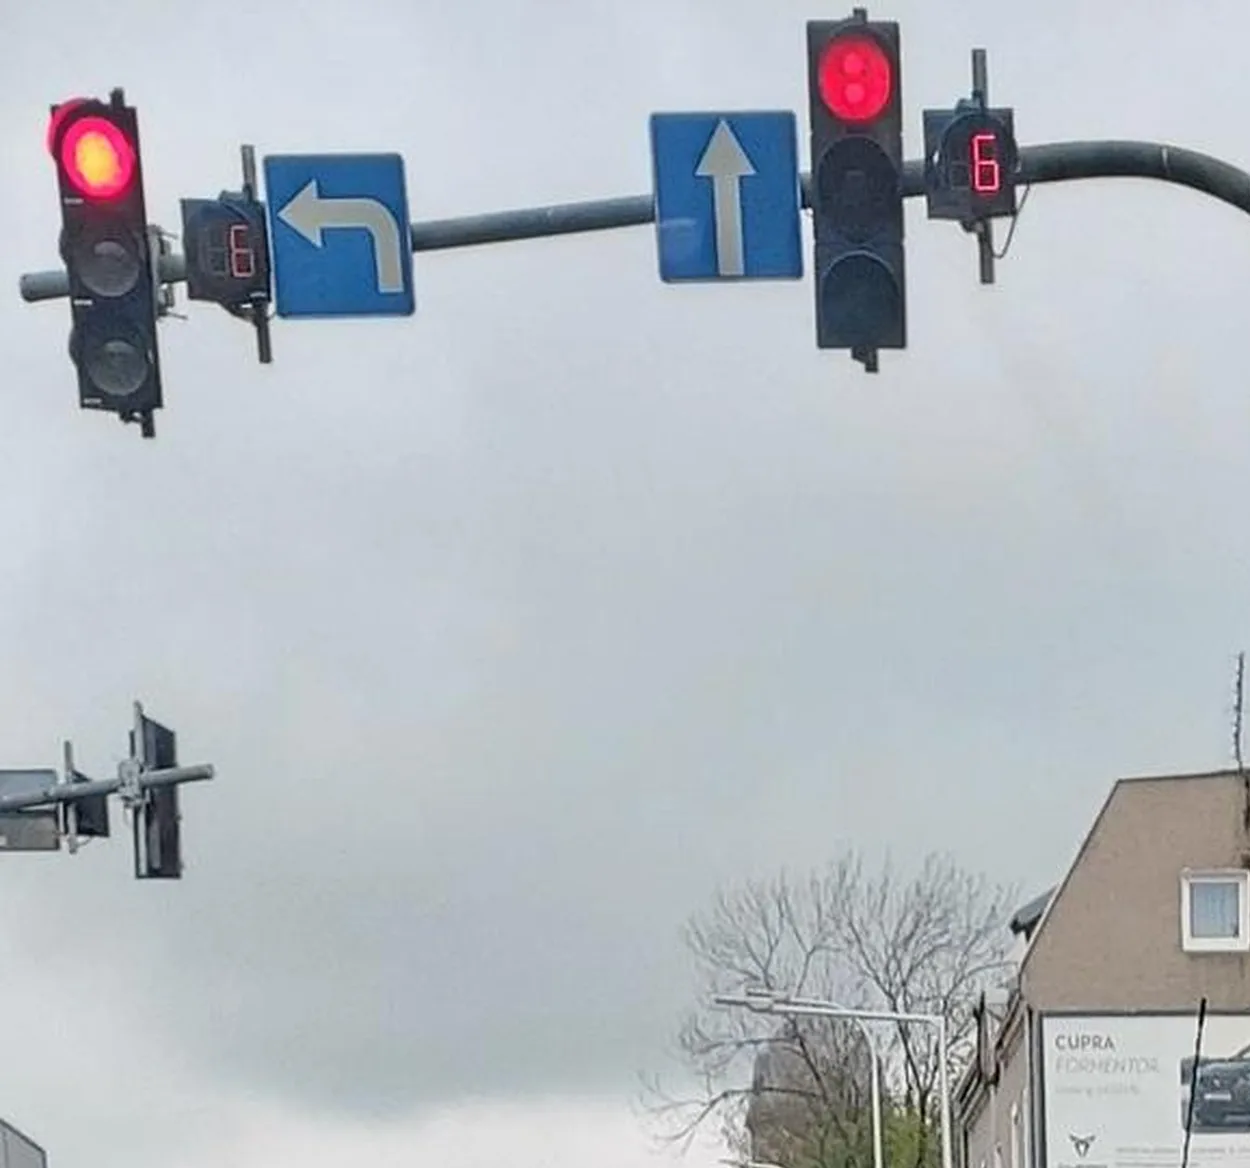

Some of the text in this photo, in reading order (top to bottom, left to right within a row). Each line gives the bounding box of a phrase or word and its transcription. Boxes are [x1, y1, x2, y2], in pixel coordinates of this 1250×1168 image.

[973, 134, 1000, 191] 6
[231, 224, 255, 277] 6
[1054, 1033, 1115, 1051] CUPRA
